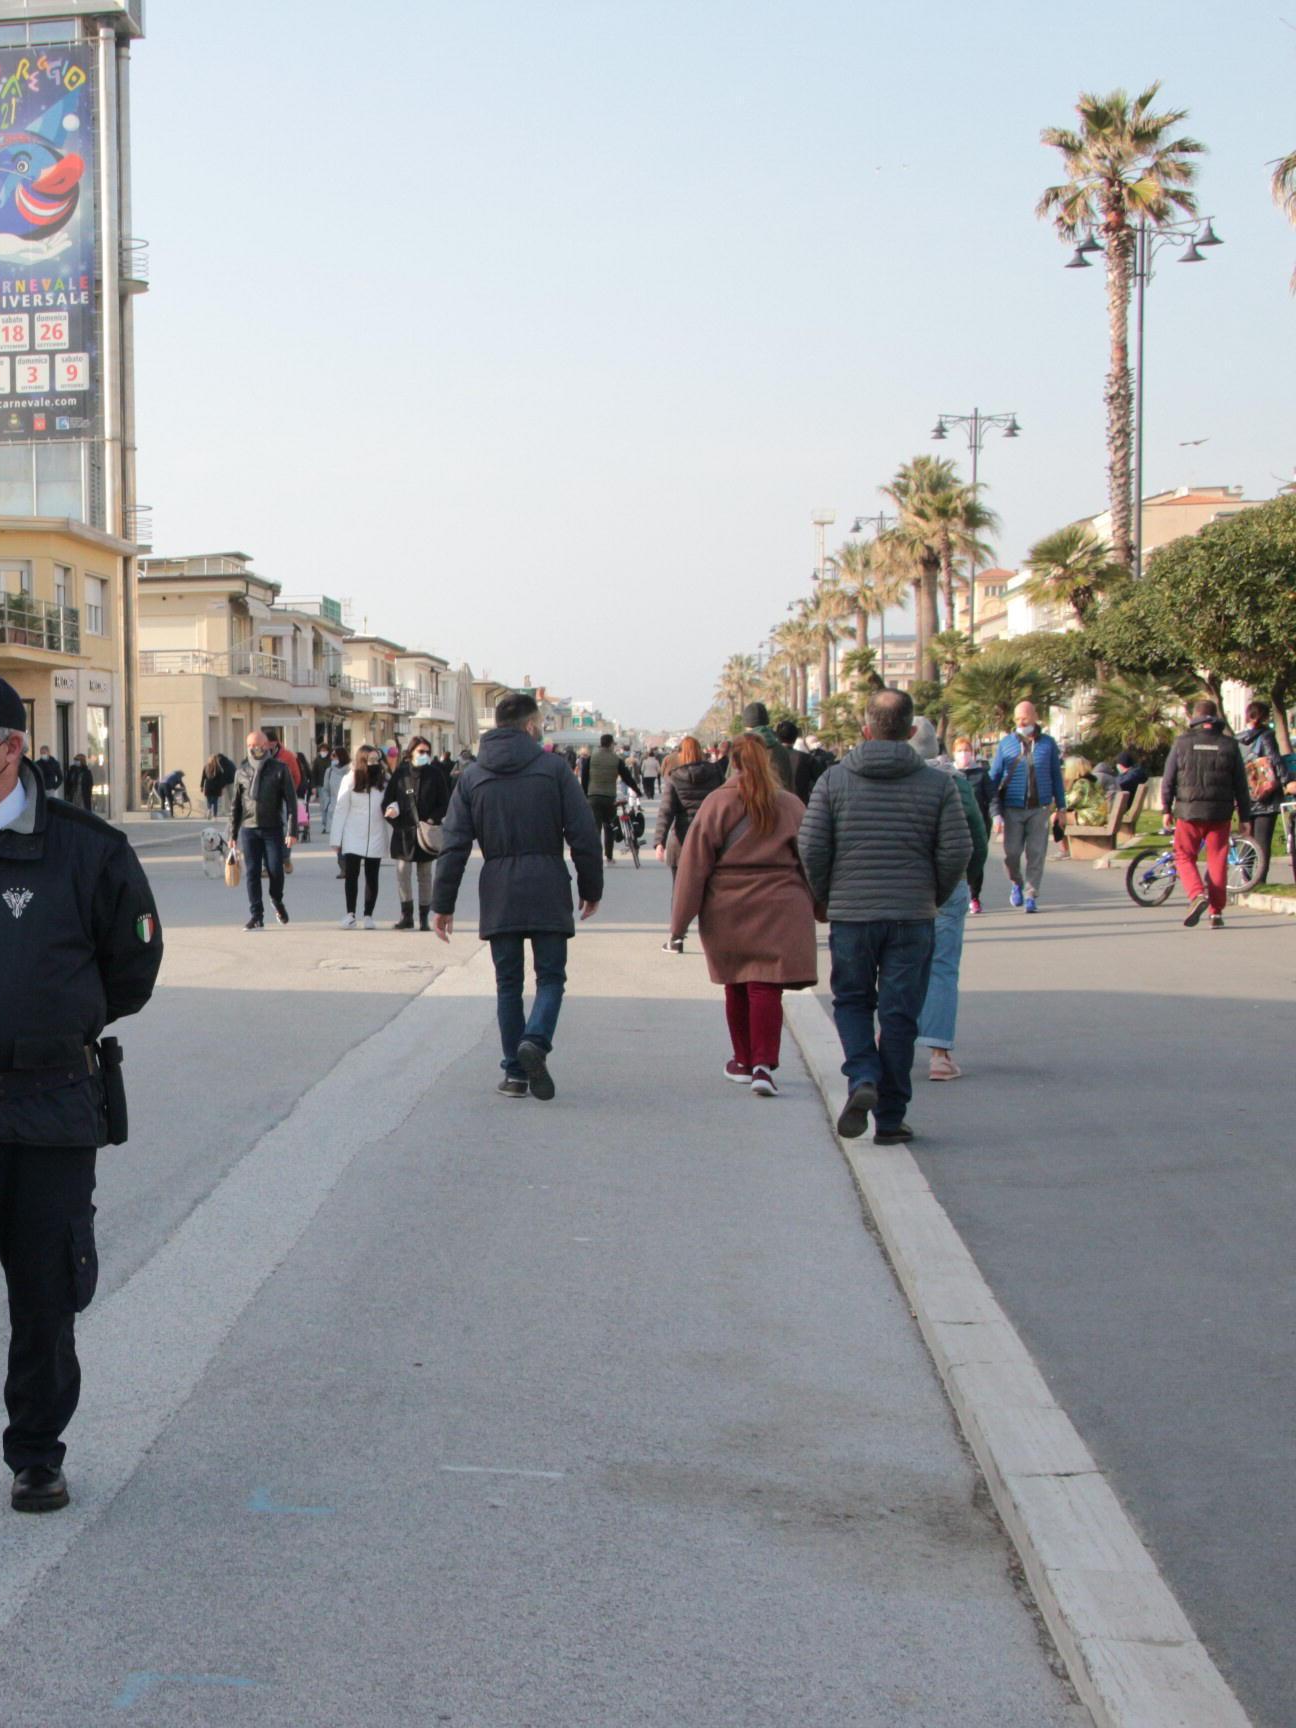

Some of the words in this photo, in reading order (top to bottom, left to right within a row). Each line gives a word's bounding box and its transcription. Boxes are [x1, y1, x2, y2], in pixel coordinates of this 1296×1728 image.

[36, 313, 67, 322] domenica
[1, 325, 24, 343] 18
[40, 322, 64, 341] 26
[17, 356, 48, 365] domenica
[27, 366, 38, 383] 3
[66, 364, 78, 382] 9
